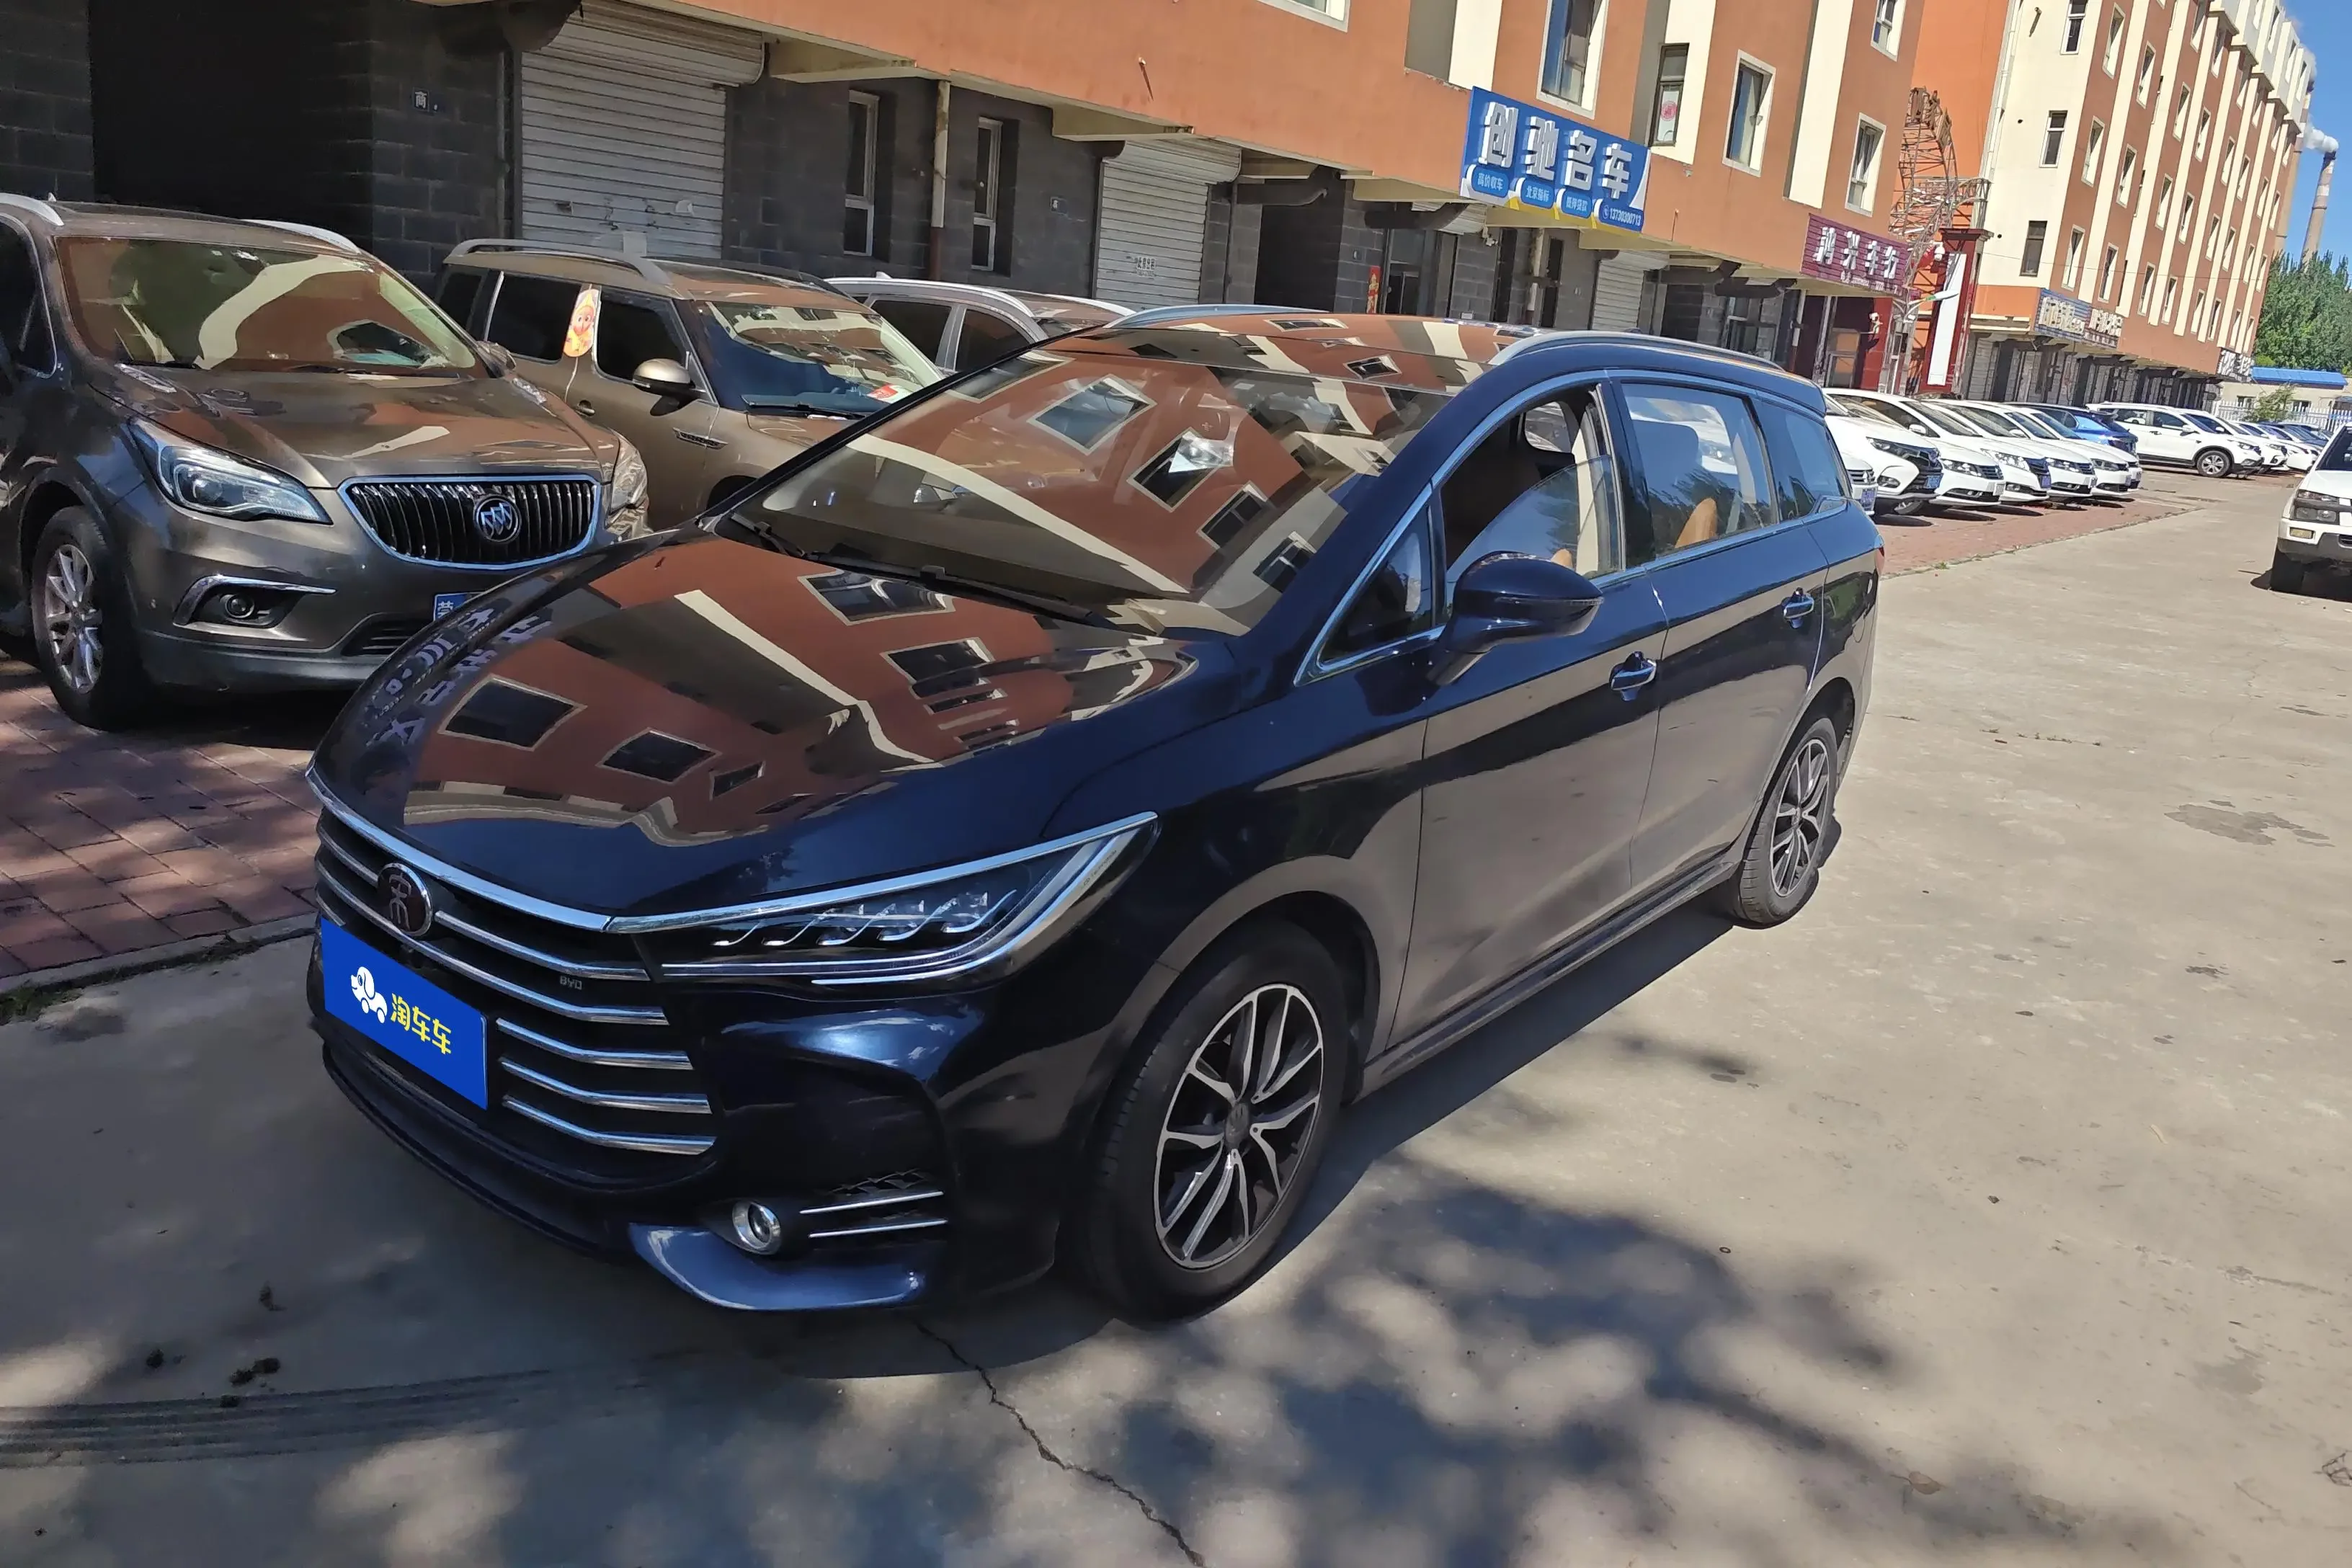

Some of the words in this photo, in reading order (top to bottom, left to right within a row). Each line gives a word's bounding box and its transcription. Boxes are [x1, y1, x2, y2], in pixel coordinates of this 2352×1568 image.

[1479, 102, 1634, 200] 创驰名车
[1476, 172, 1504, 191] 高价收车
[1525, 184, 1551, 202] 北京指标
[1608, 207, 1642, 226] 13730300713
[559, 975, 583, 991] BYD
